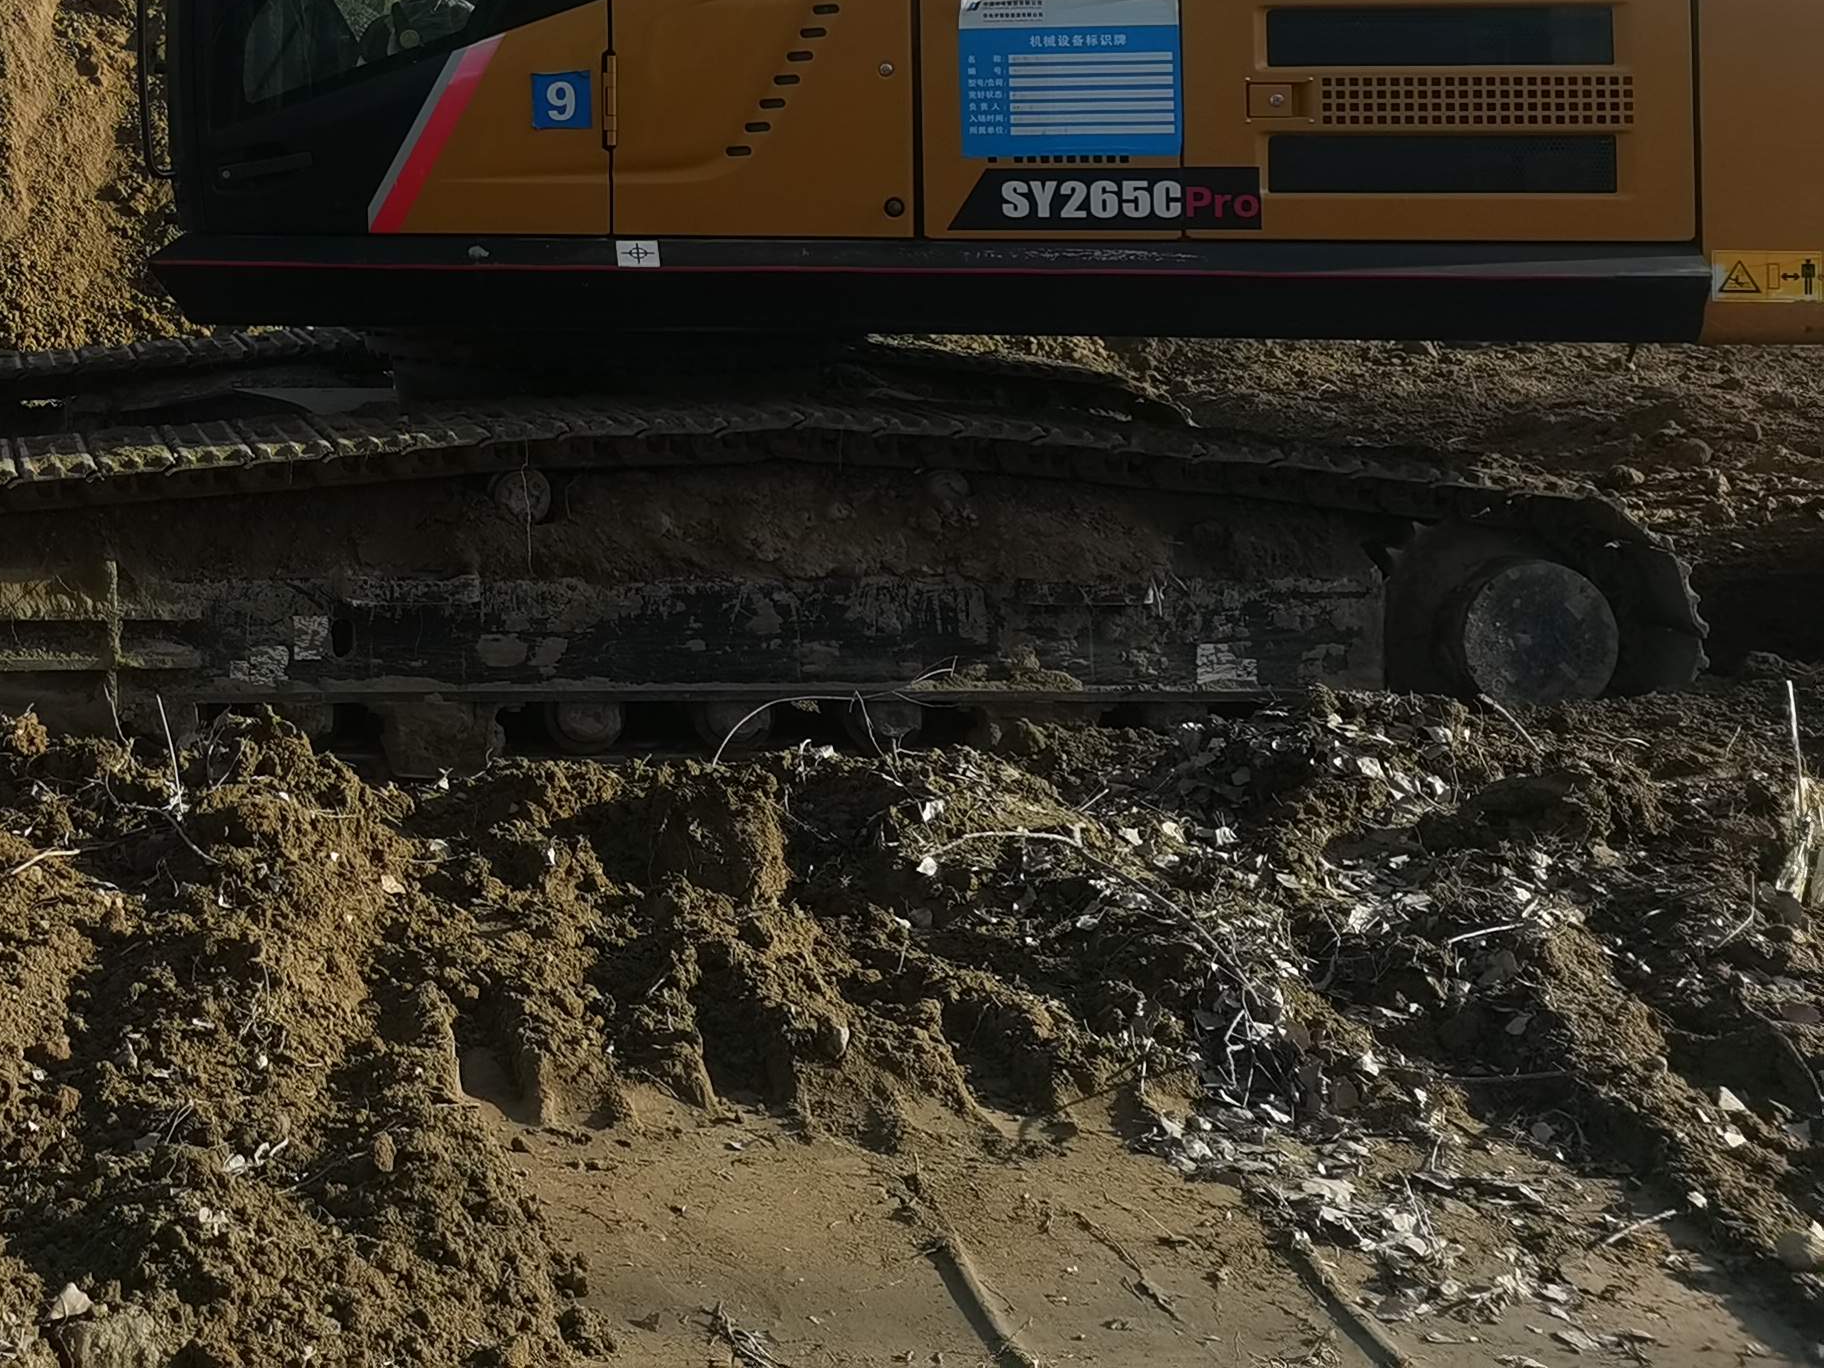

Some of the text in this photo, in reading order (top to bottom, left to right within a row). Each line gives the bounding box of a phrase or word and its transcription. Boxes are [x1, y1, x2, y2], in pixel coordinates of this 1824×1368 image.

[1029, 33, 1127, 48] 机械设备标识牌
[547, 81, 575, 121] 9
